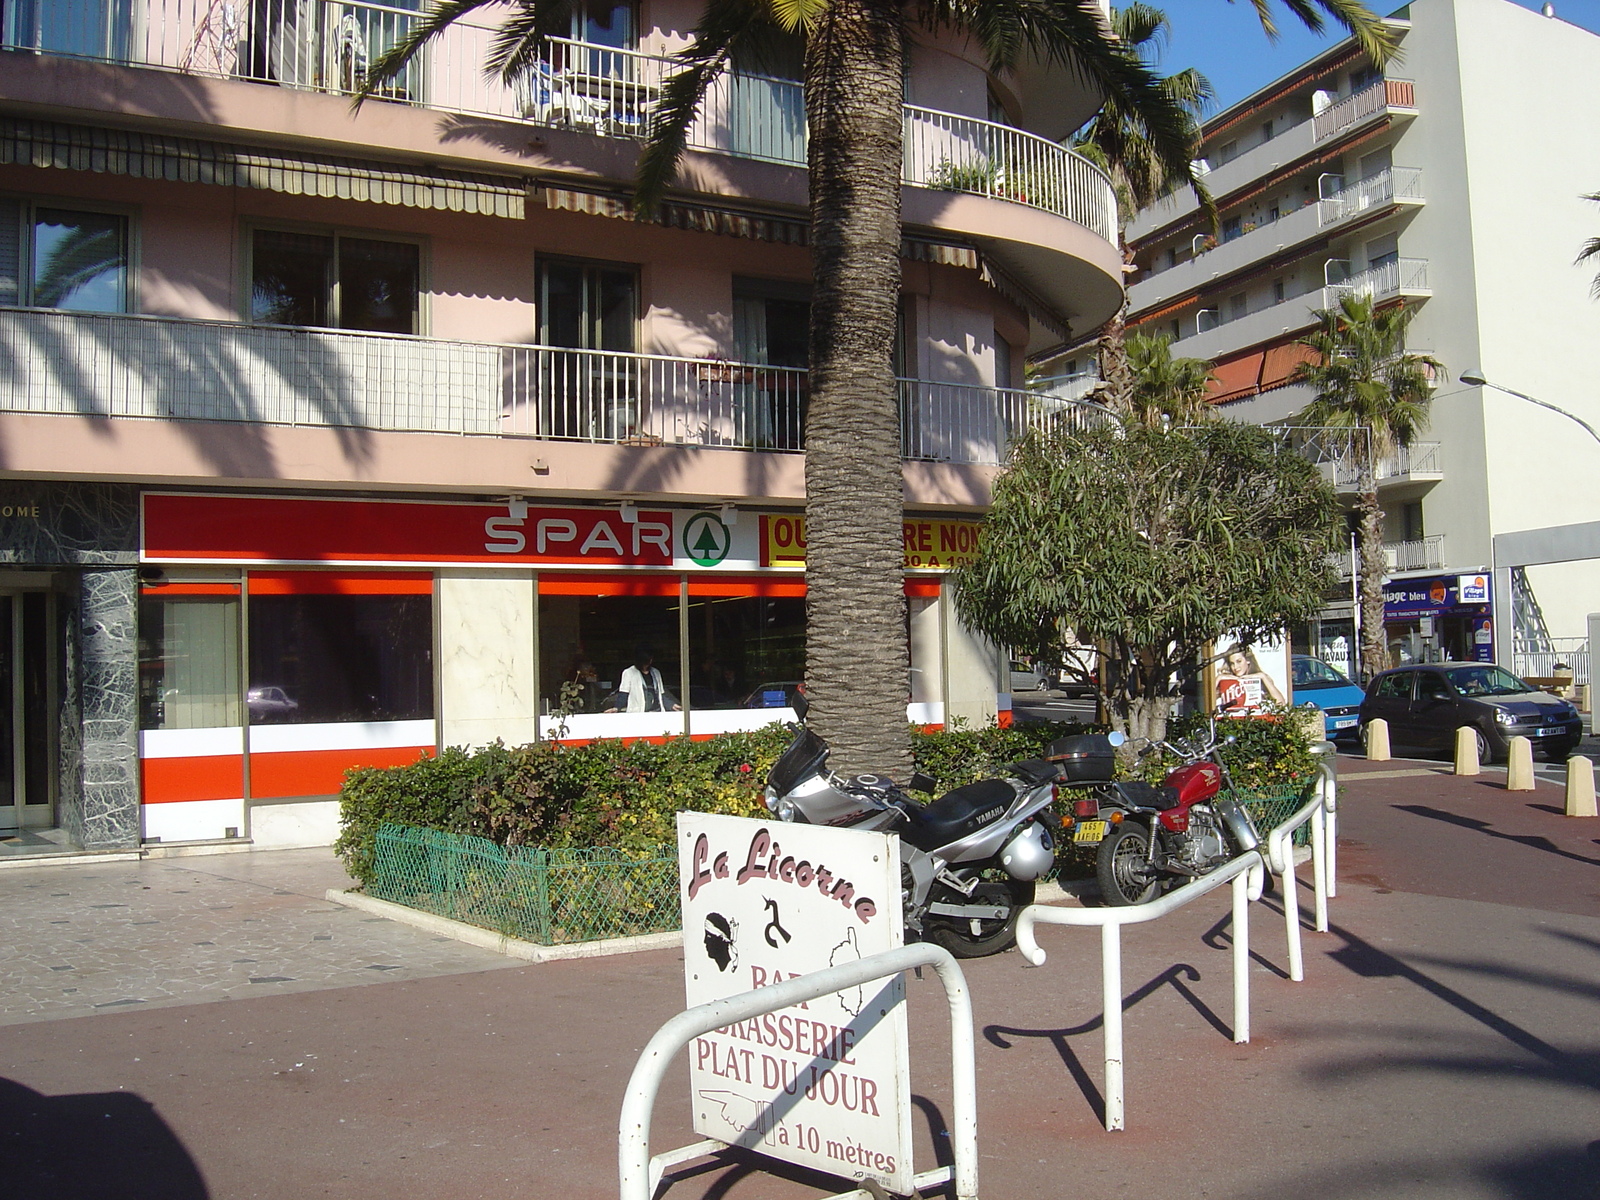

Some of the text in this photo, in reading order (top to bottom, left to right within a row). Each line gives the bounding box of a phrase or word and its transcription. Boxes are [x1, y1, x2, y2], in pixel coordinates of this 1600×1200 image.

[484, 516, 671, 557] SPAR
[774, 517, 807, 549] OU
[1381, 588, 1426, 604] llage bleu
[975, 805, 1005, 825] YAMAHA
[688, 828, 877, 924] La Licorne
[714, 1012, 856, 1066] RASSERIE
[697, 1037, 880, 1117] PLAT DU JOUR
[778, 1118, 896, 1174] à 10 mètres
